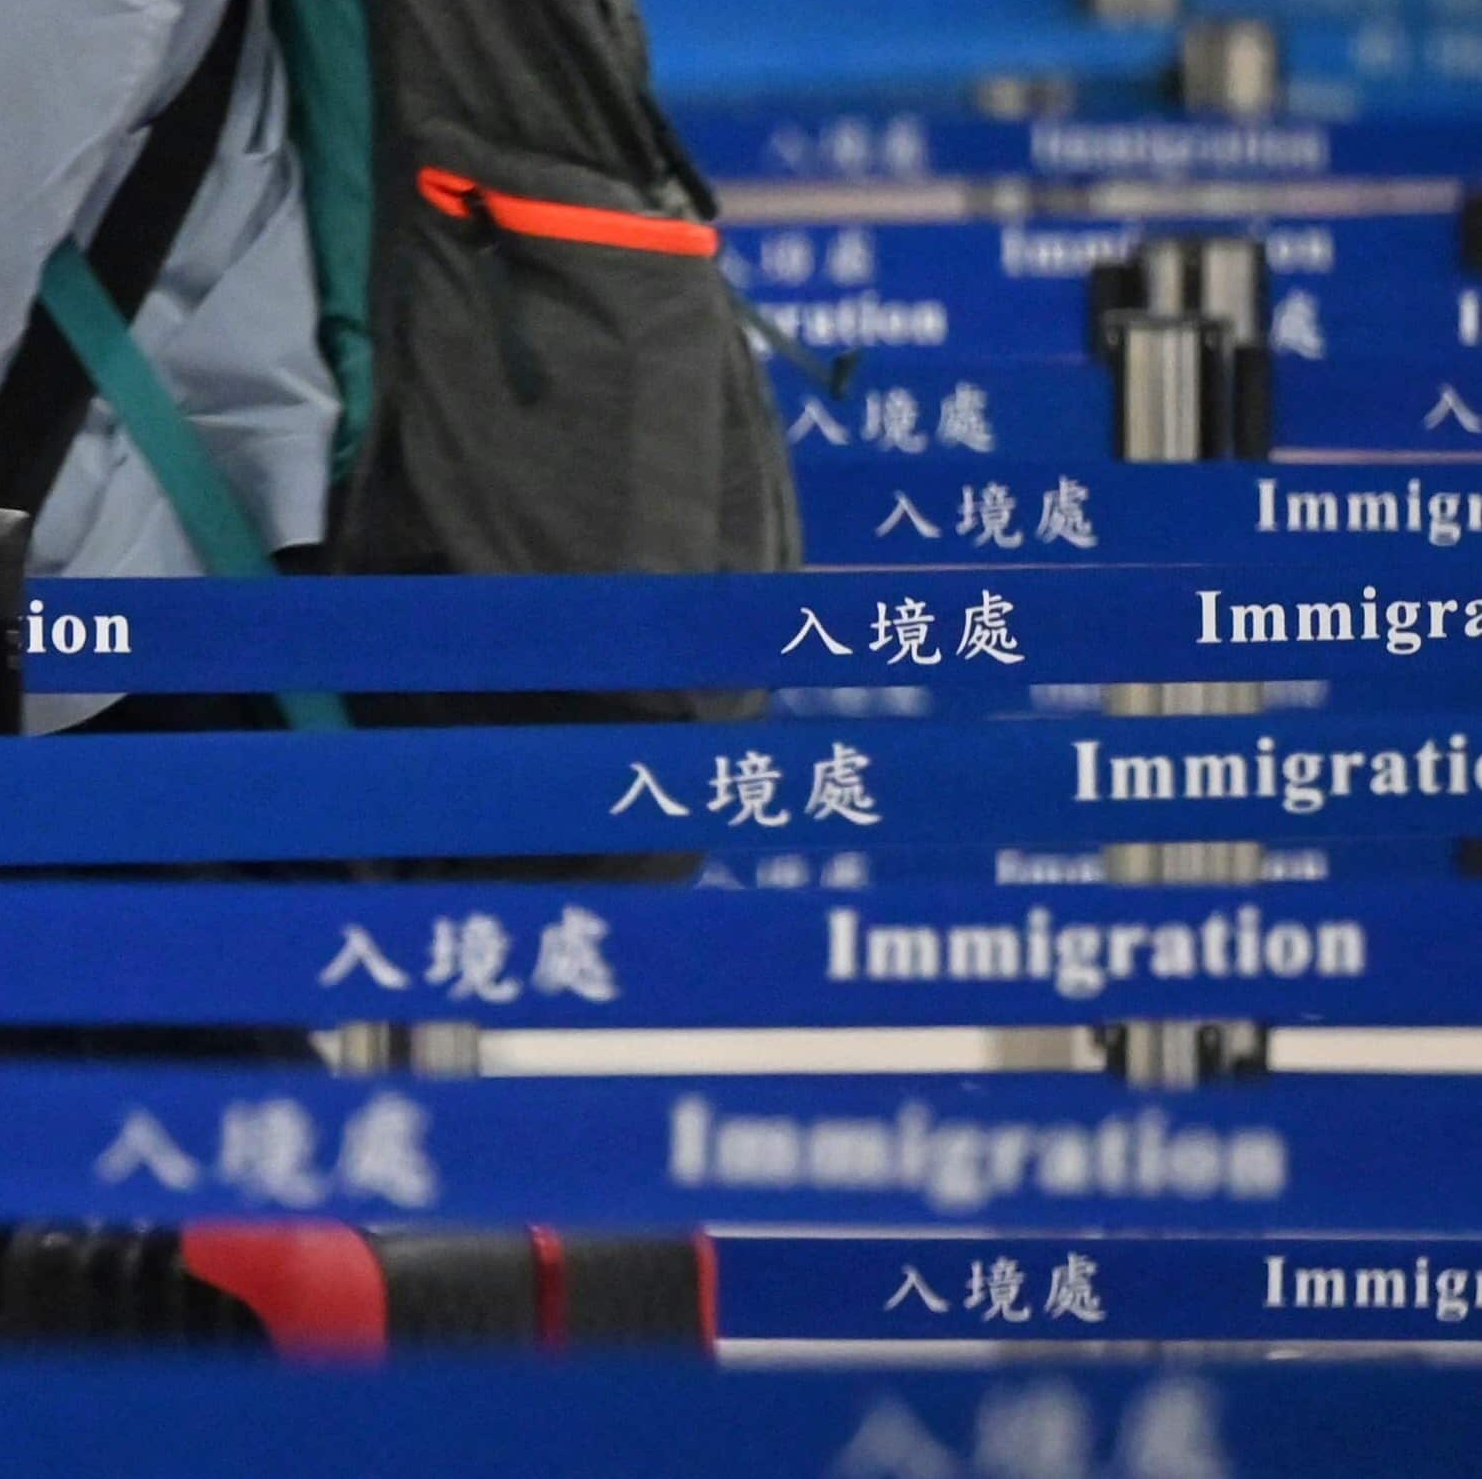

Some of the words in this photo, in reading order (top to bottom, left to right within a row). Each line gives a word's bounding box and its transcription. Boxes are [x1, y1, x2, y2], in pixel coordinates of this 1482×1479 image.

[877, 476, 1097, 549] 入境處
[781, 589, 1025, 665] 入境處
[610, 742, 881, 827] 入境處
[1073, 733, 1482, 814] Immigrati
[321, 906, 616, 1003] 入境處
[828, 905, 1365, 997] Immigration
[670, 1096, 1286, 1210] Immigration
[886, 1252, 1105, 1323] 入境處
[1266, 1256, 1482, 1321] Immig
